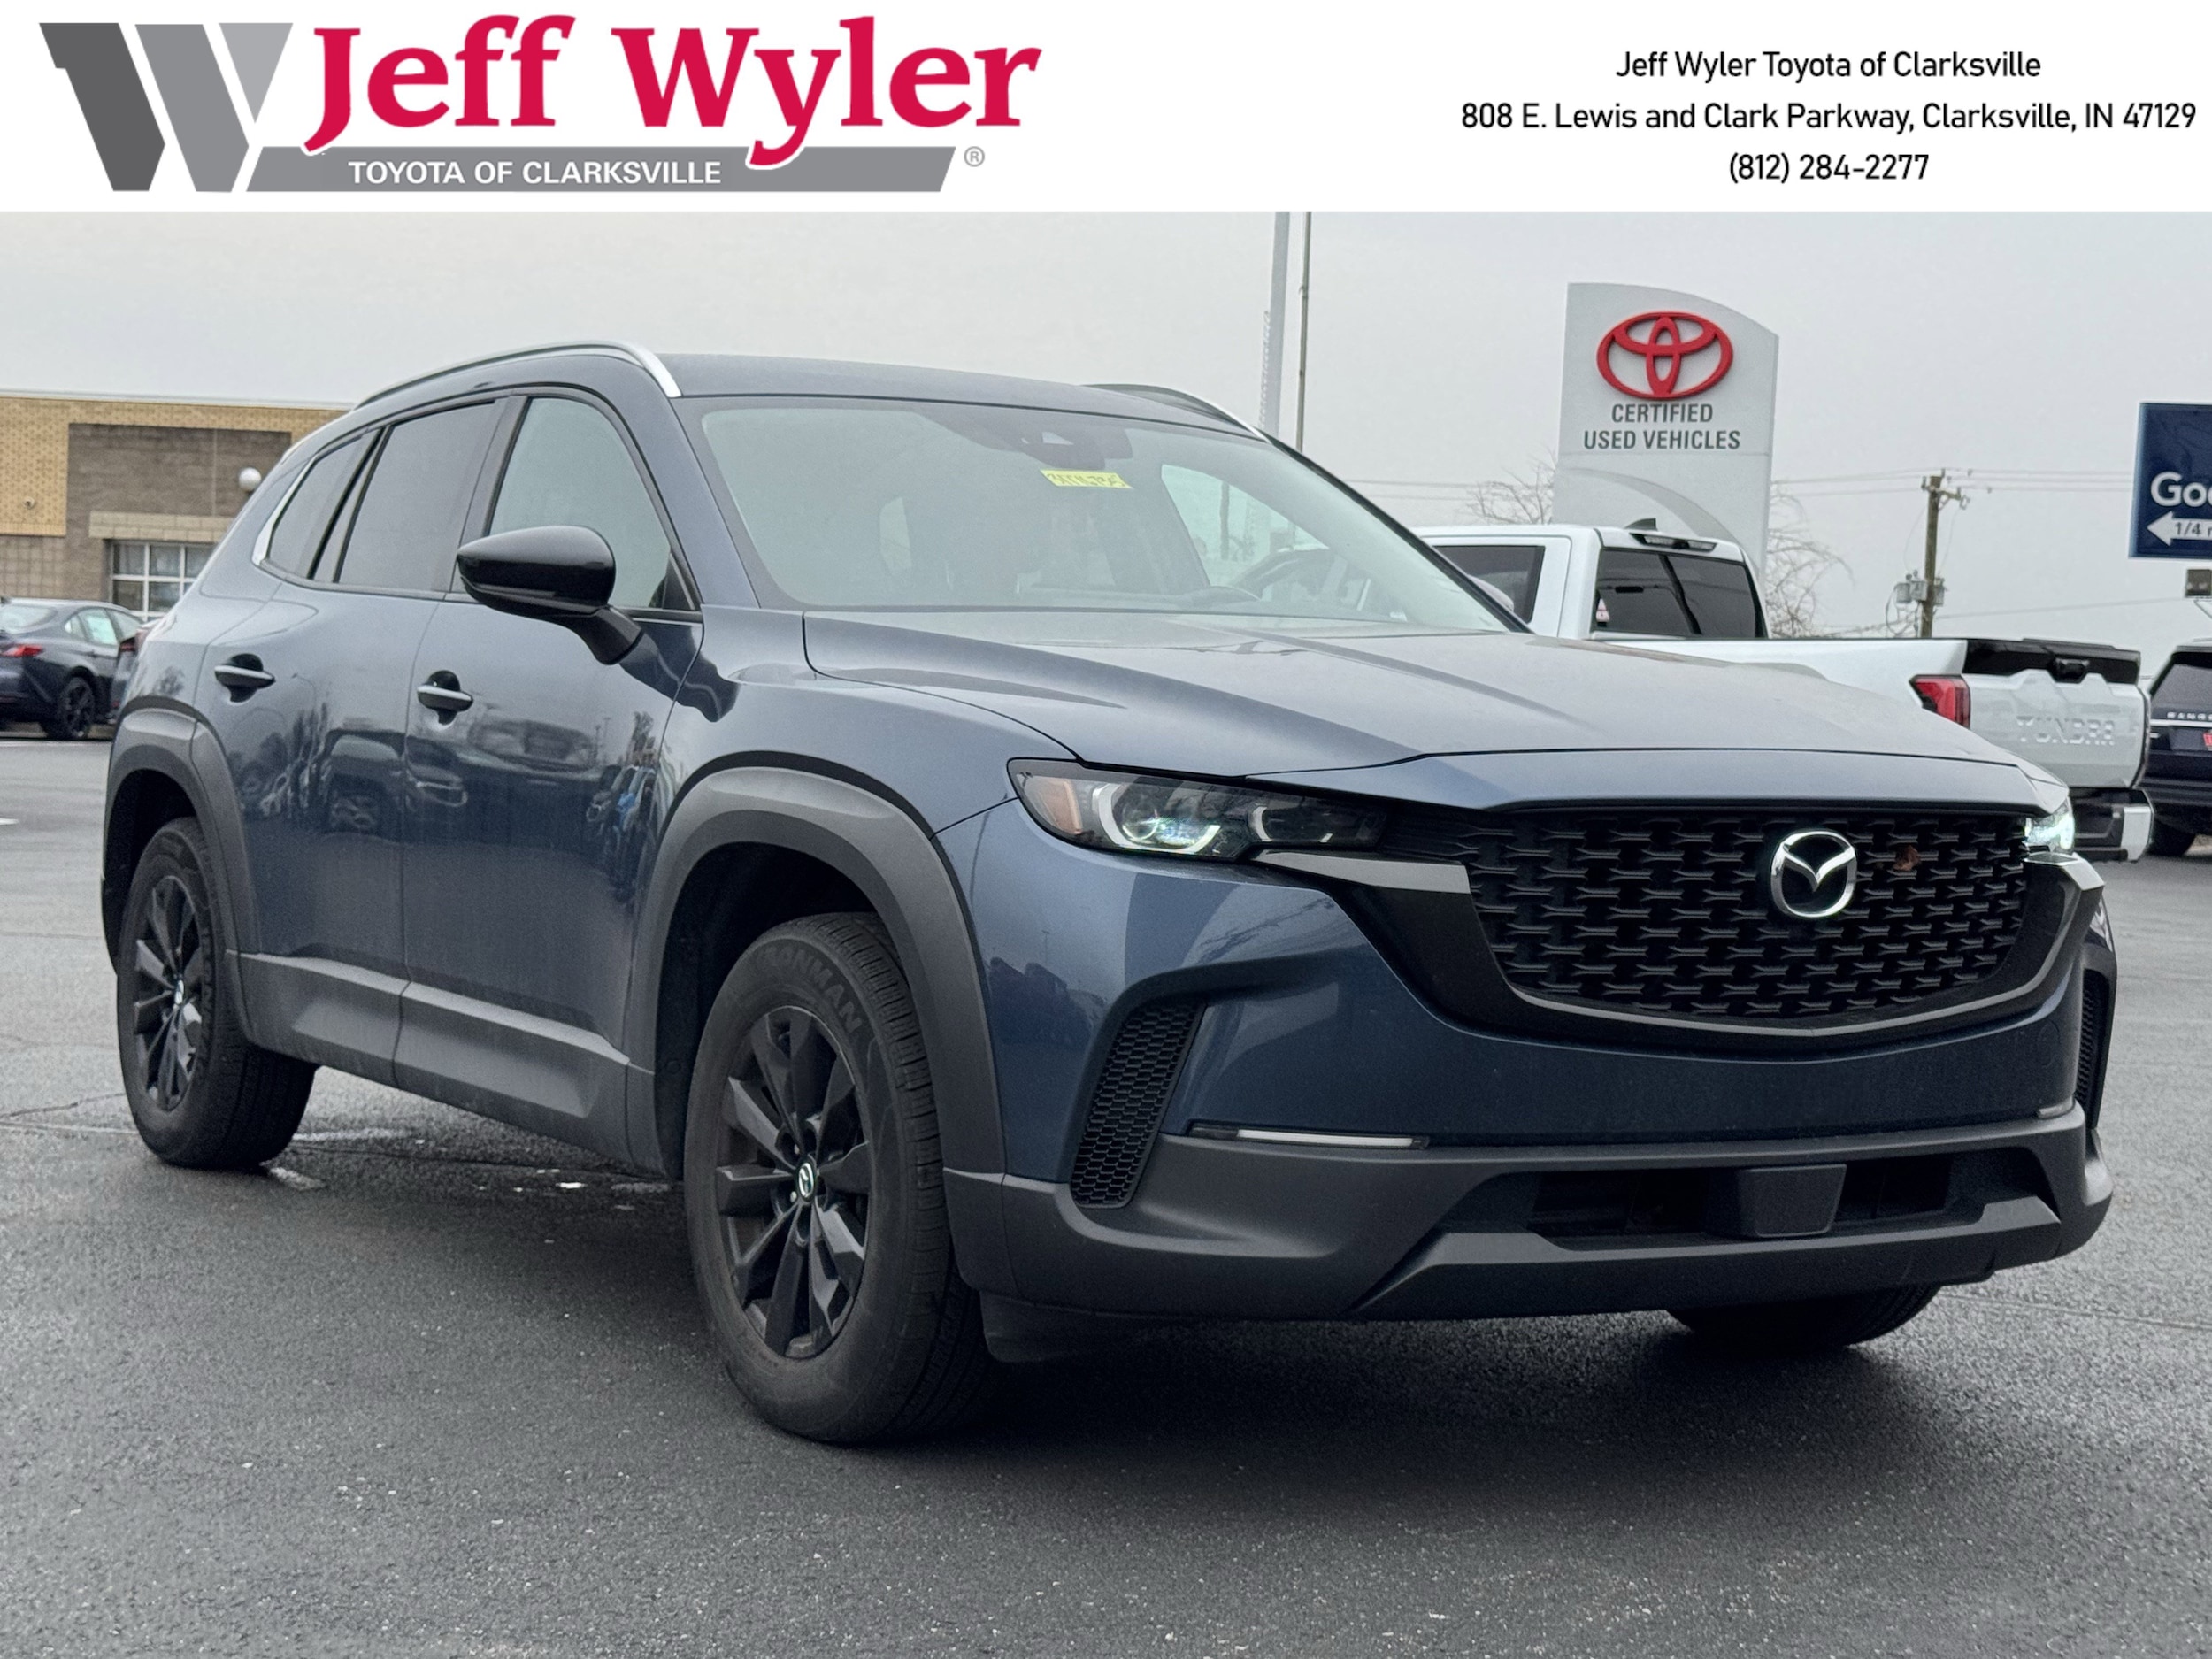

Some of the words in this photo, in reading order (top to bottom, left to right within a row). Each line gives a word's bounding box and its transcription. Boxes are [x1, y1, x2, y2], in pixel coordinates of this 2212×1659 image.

[1610, 403, 1714, 423] CERTIFIED
[1583, 430, 1637, 449] USED
[1643, 430, 1741, 450] VEHICLES
[2150, 471, 2212, 508] Go
[2174, 521, 2202, 537] 1/4
[2016, 715, 2115, 746] TUNDRA
